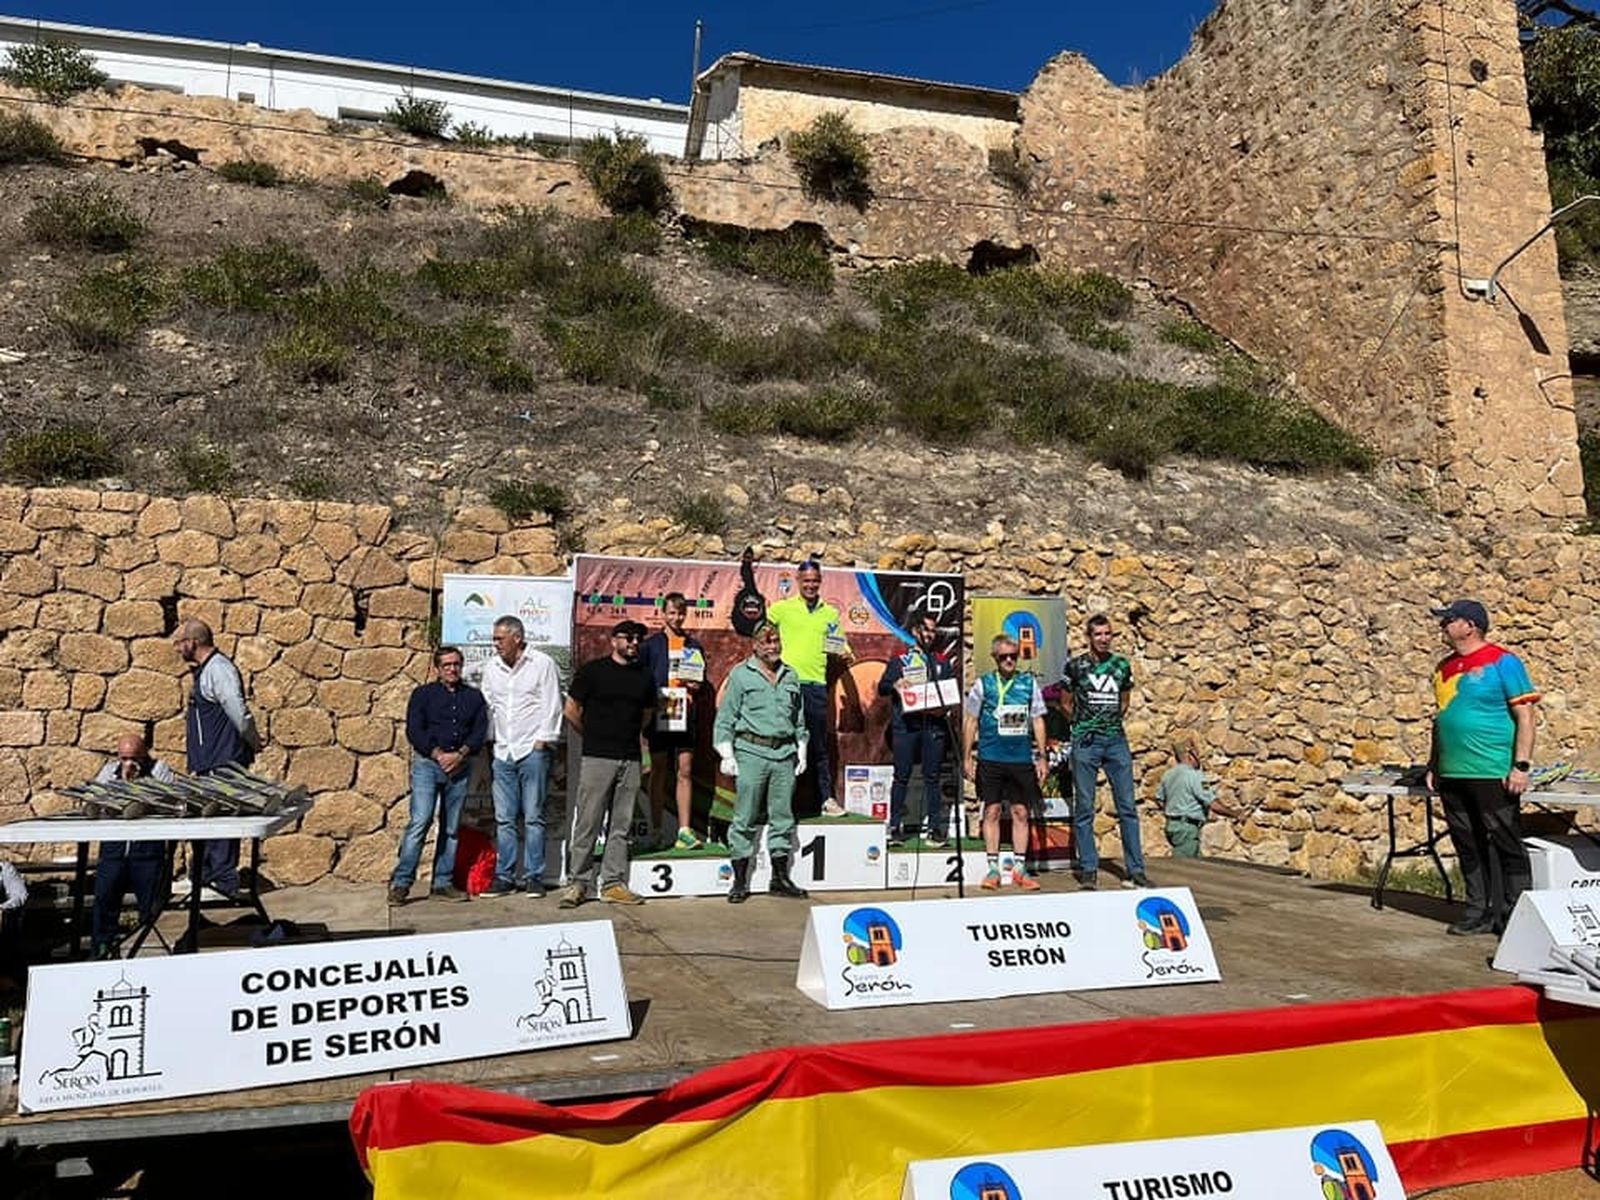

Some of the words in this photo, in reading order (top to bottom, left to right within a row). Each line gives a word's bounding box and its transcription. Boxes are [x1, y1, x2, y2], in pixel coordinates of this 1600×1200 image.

[801, 834, 826, 881] 1
[946, 856, 964, 882] 2
[651, 864, 673, 893] 3
[966, 921, 1072, 942] TURISMO
[988, 944, 1067, 969] SERÓN
[1141, 951, 1204, 979] Serón
[241, 951, 459, 995] CONCEJALÍA
[841, 966, 913, 997] Serón
[231, 1005, 278, 1032] DE
[291, 985, 470, 1025] DEPORTES
[266, 1038, 312, 1066] DE
[325, 1020, 441, 1058] SERÓN
[1103, 1171, 1233, 1200] TURISMO
